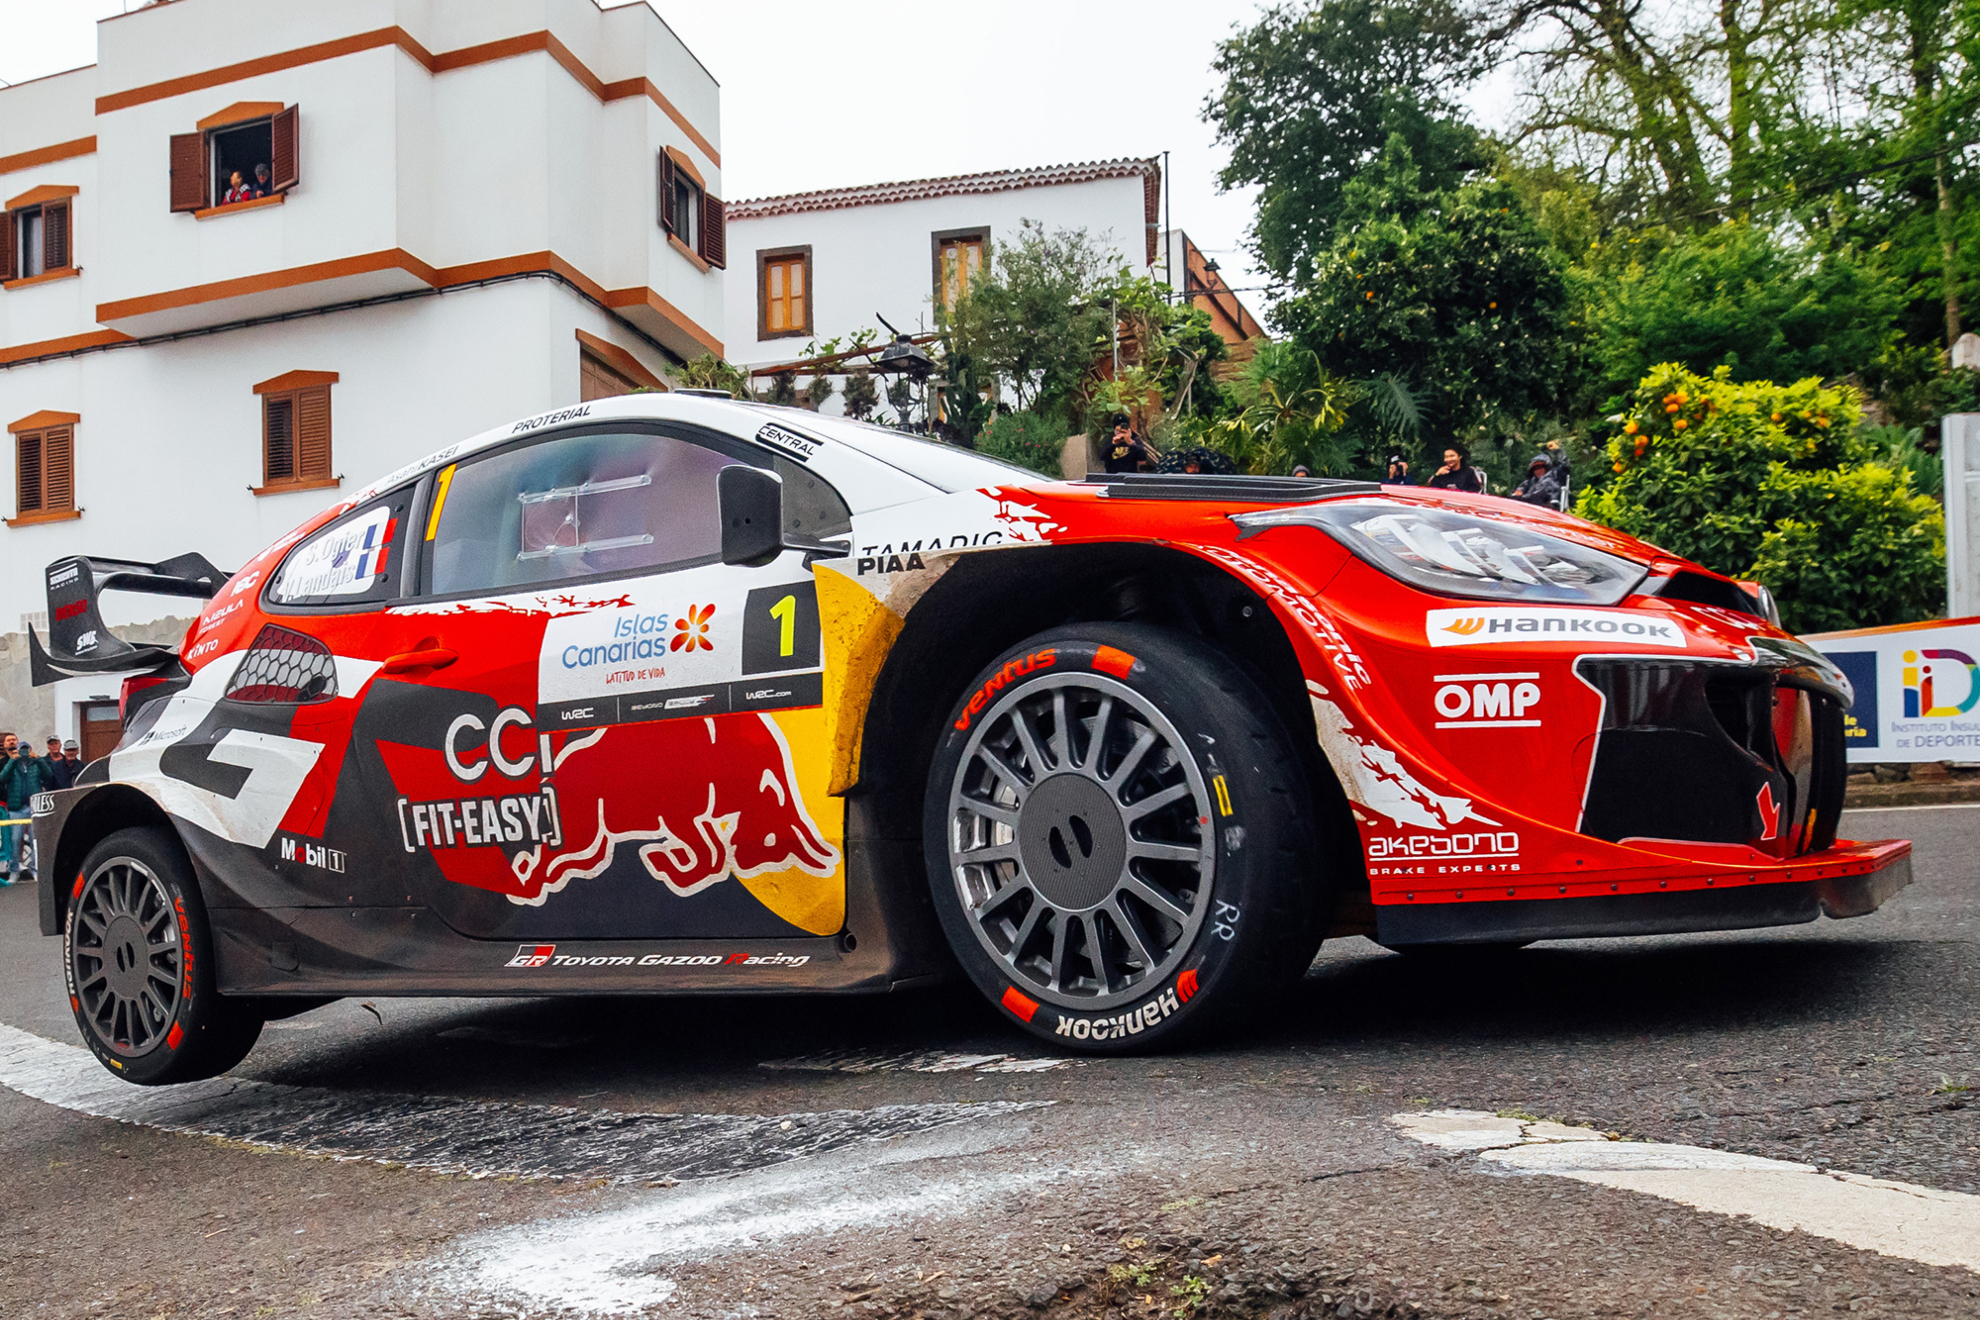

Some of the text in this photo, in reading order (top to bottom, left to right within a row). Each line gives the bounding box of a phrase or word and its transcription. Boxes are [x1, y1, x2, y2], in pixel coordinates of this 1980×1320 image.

[512, 405, 592, 434] PROTERIAL
[758, 425, 815, 456] CENTRAL
[425, 463, 458, 541] 1
[857, 552, 926, 576] PIAA
[55, 598, 88, 622] DENSO
[613, 613, 669, 638] Islas
[769, 594, 797, 657] 1
[562, 636, 666, 669] Canarias
[606, 667, 667, 684] LATITUD DE VIDA
[1434, 682, 1541, 718] OMP
[561, 707, 595, 720] WRC
[151, 723, 188, 742] Microsoft
[280, 837, 327, 869] Mobil
[1368, 832, 1520, 857] akebono
[1369, 866, 1426, 876] BRAKE
[723, 951, 811, 968] Racing
